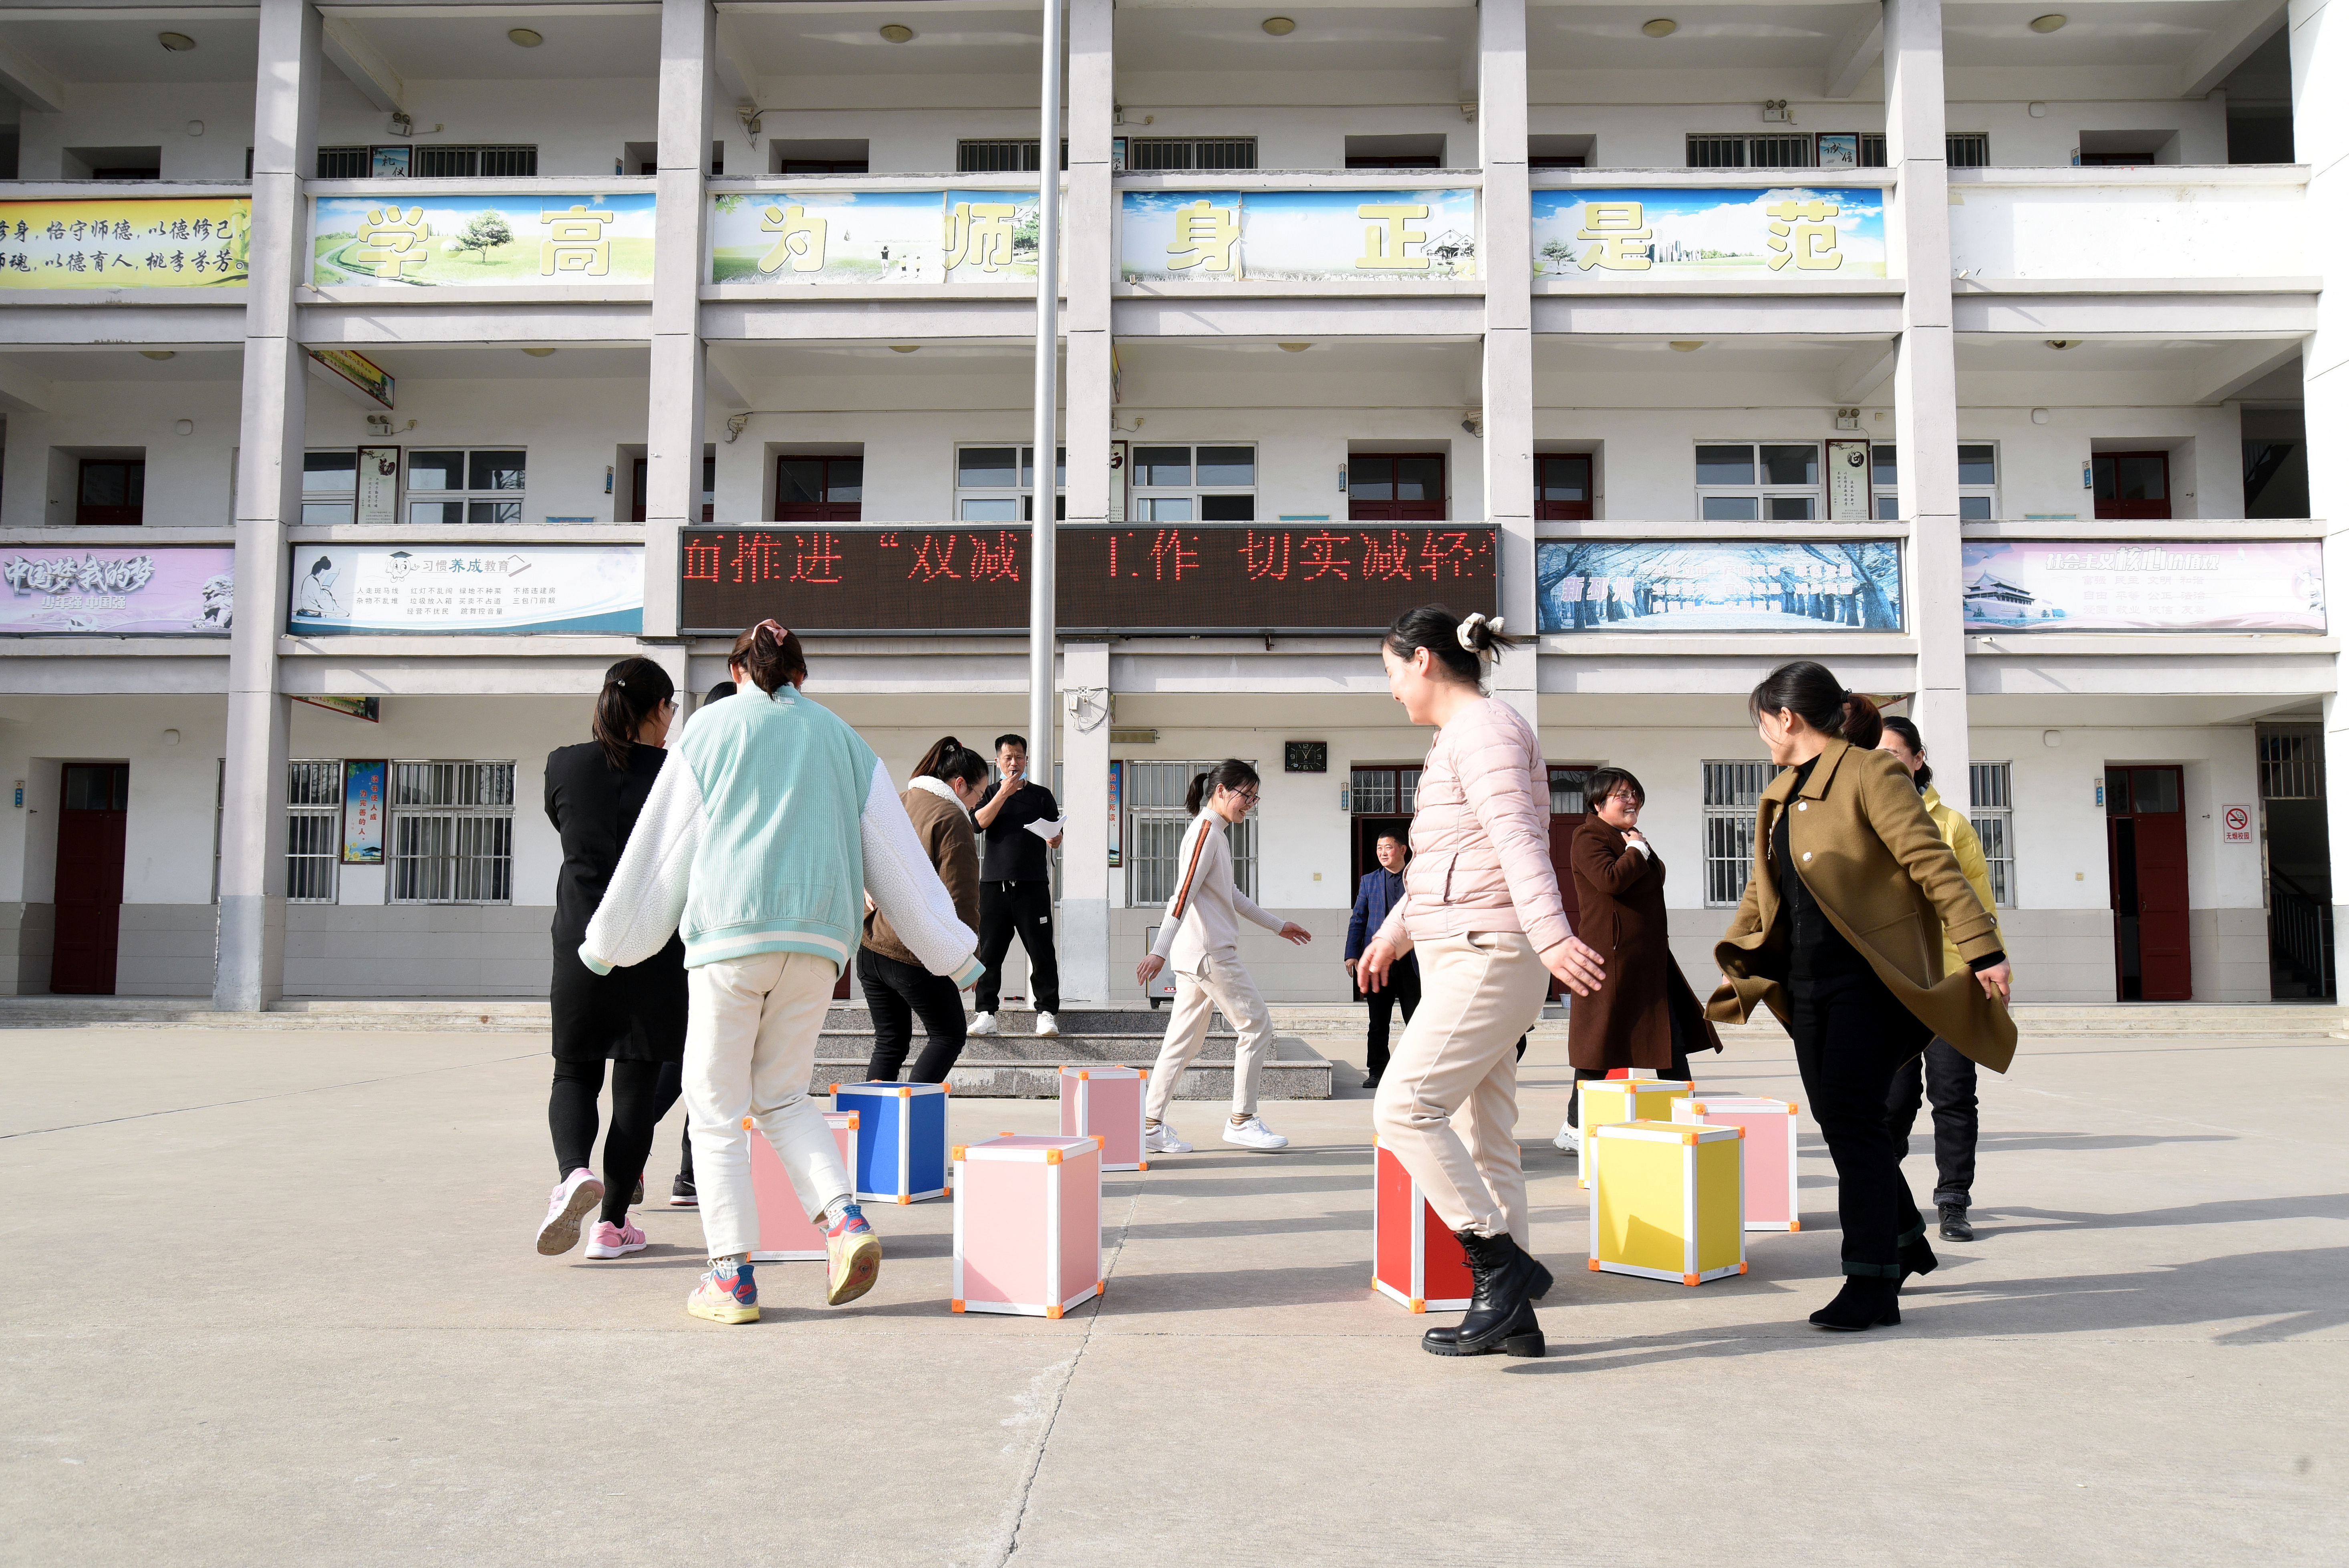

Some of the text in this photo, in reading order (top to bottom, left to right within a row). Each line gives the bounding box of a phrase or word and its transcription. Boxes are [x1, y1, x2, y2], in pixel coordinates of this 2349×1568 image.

[1823, 142, 1853, 163] 诚信
[358, 205, 613, 278] 学 高
[757, 202, 1015, 274] 为 师
[1166, 200, 1430, 272] 身 正
[1576, 201, 1843, 271] 是 范
[423, 558, 510, 573] 习惯养成教育
[2045, 547, 2220, 571] 社会主义核心价值观
[1652, 565, 1852, 576] 工业立市 产业强市 绿色发展
[2082, 576, 2204, 585] 富强 民主 文明 和谐
[1561, 577, 1634, 602] 新邳州
[1652, 583, 1853, 595] 生态富民 宜游宜居 城乡美丽
[2084, 591, 2205, 600] 自由 平等 公正 法治
[42, 596, 126, 610] 少年强 中国强
[1652, 601, 1782, 613] 向善向上 文明高地
[2083, 605, 2206, 614] 爱国 敬业 诚信 友善
[370, 775, 379, 821] 读书使人成
[2226, 831, 2250, 840] 无烟校园
[849, 1218, 863, 1227] NIKE
[739, 1284, 752, 1293] NIKE
